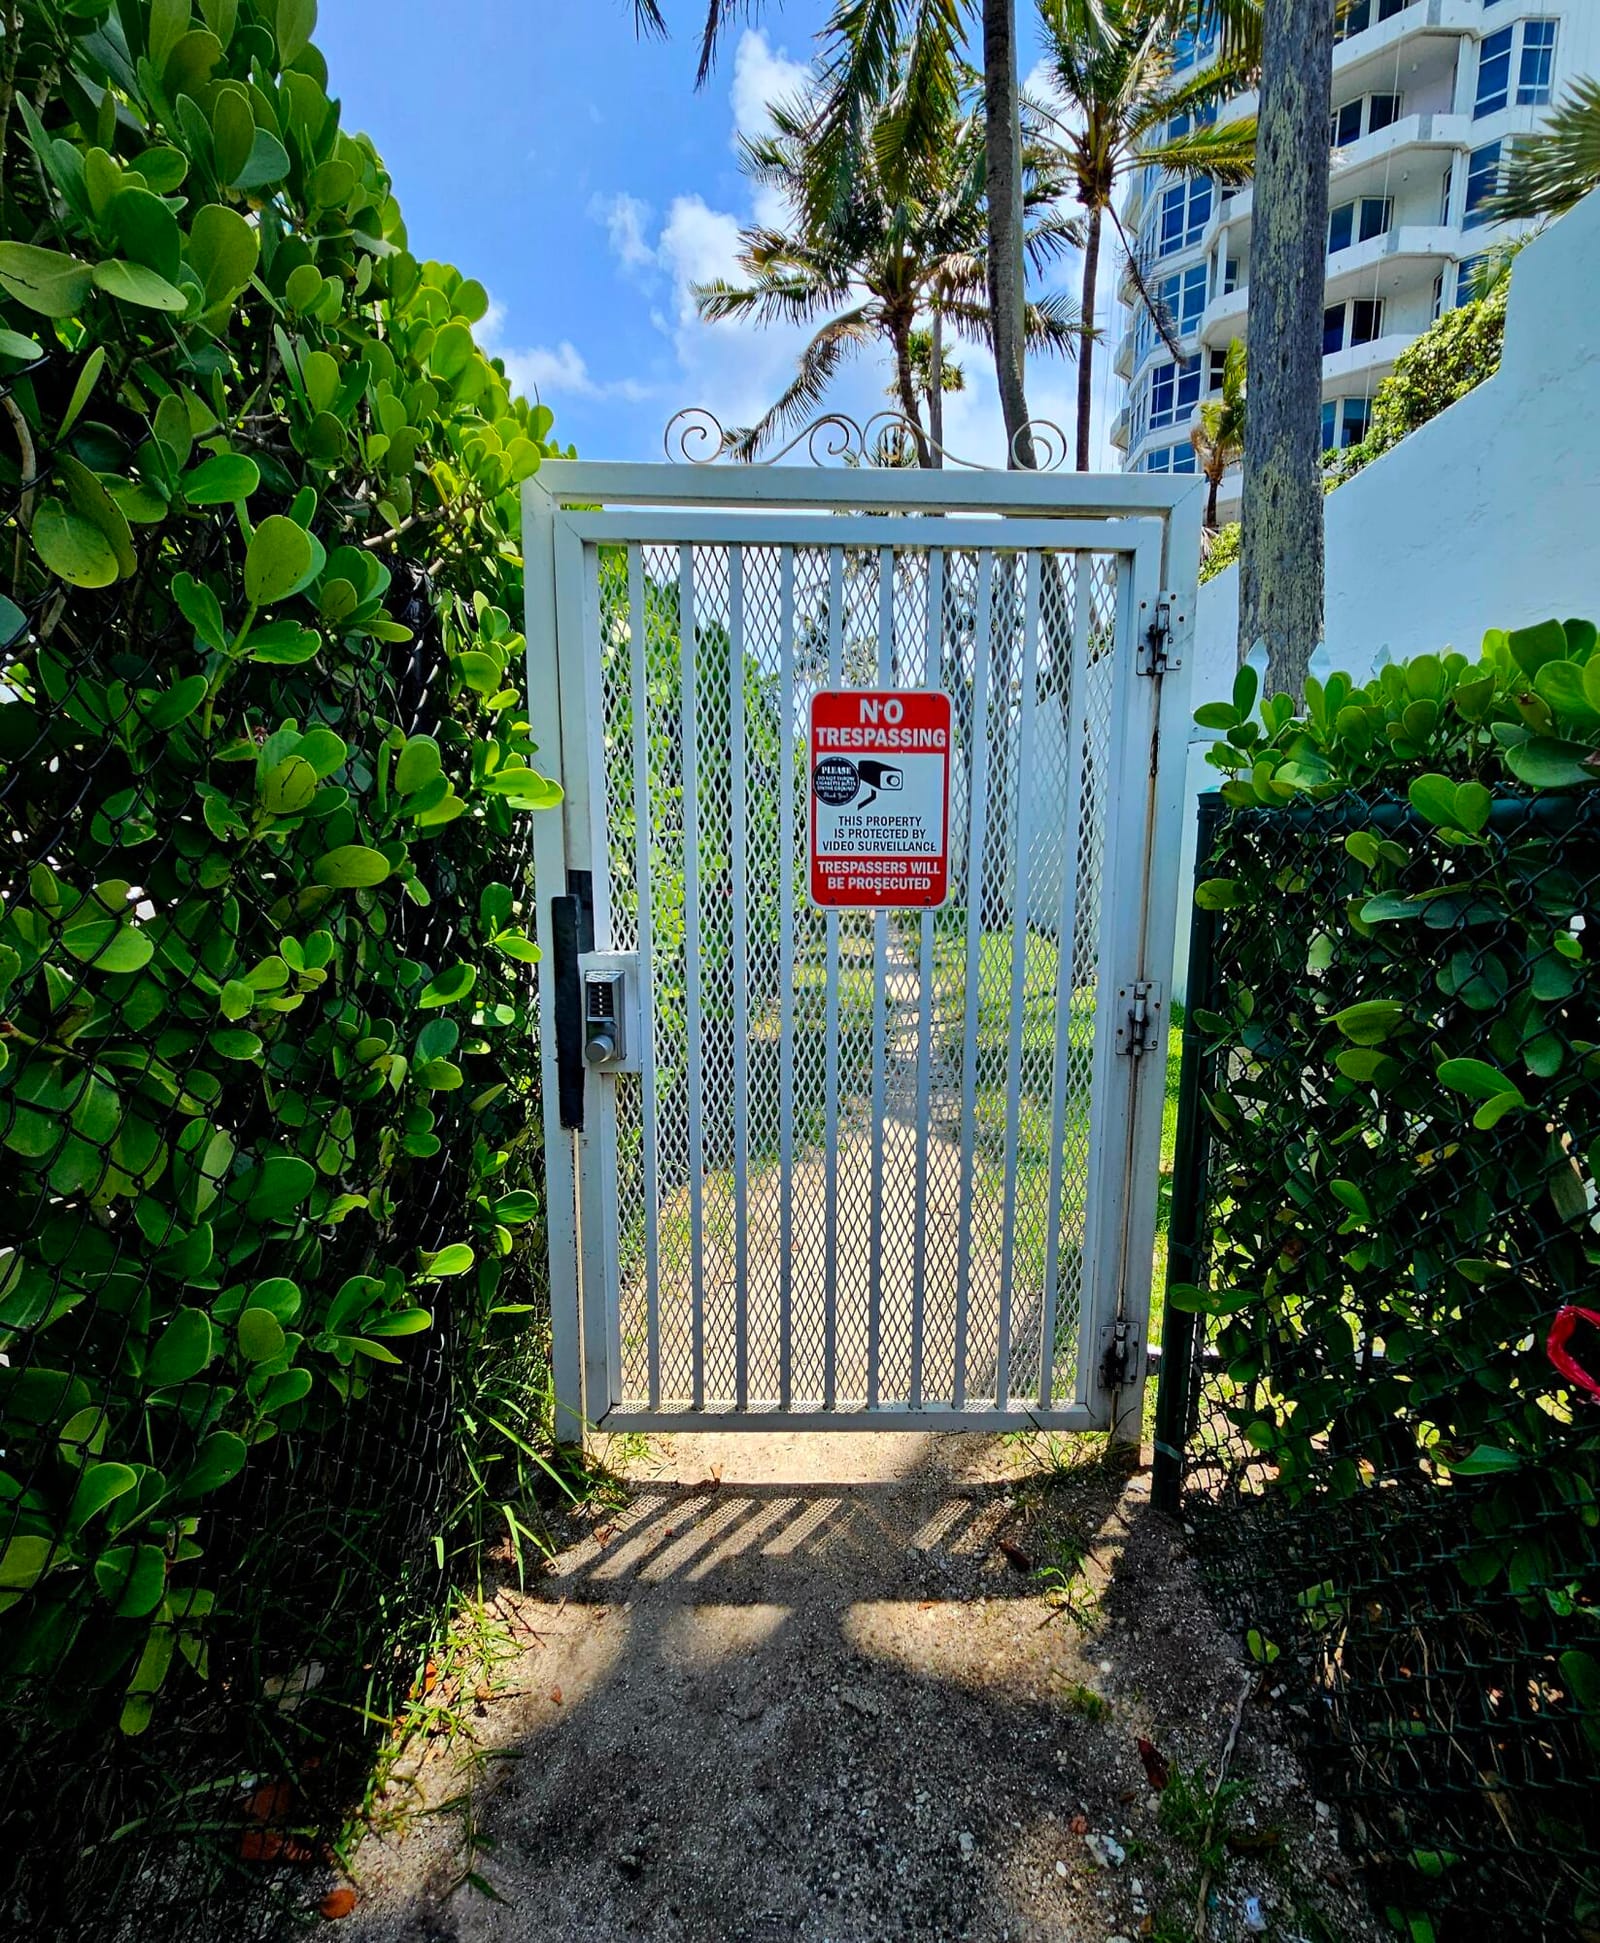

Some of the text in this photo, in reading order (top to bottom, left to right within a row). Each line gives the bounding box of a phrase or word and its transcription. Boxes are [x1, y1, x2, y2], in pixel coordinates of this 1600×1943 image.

[860, 698, 904, 724] NO
[815, 727, 946, 748] TRESPASSING
[821, 766, 852, 775] PLEASE
[838, 816, 922, 827] THIS PROPERTY
[834, 828, 926, 839] IS PROTECTED BY
[822, 841, 937, 852] VIDEO SURVEILLANCE
[817, 861, 941, 875] TRESPASSERS WILL
[827, 877, 931, 890] BE PROSECUTED
